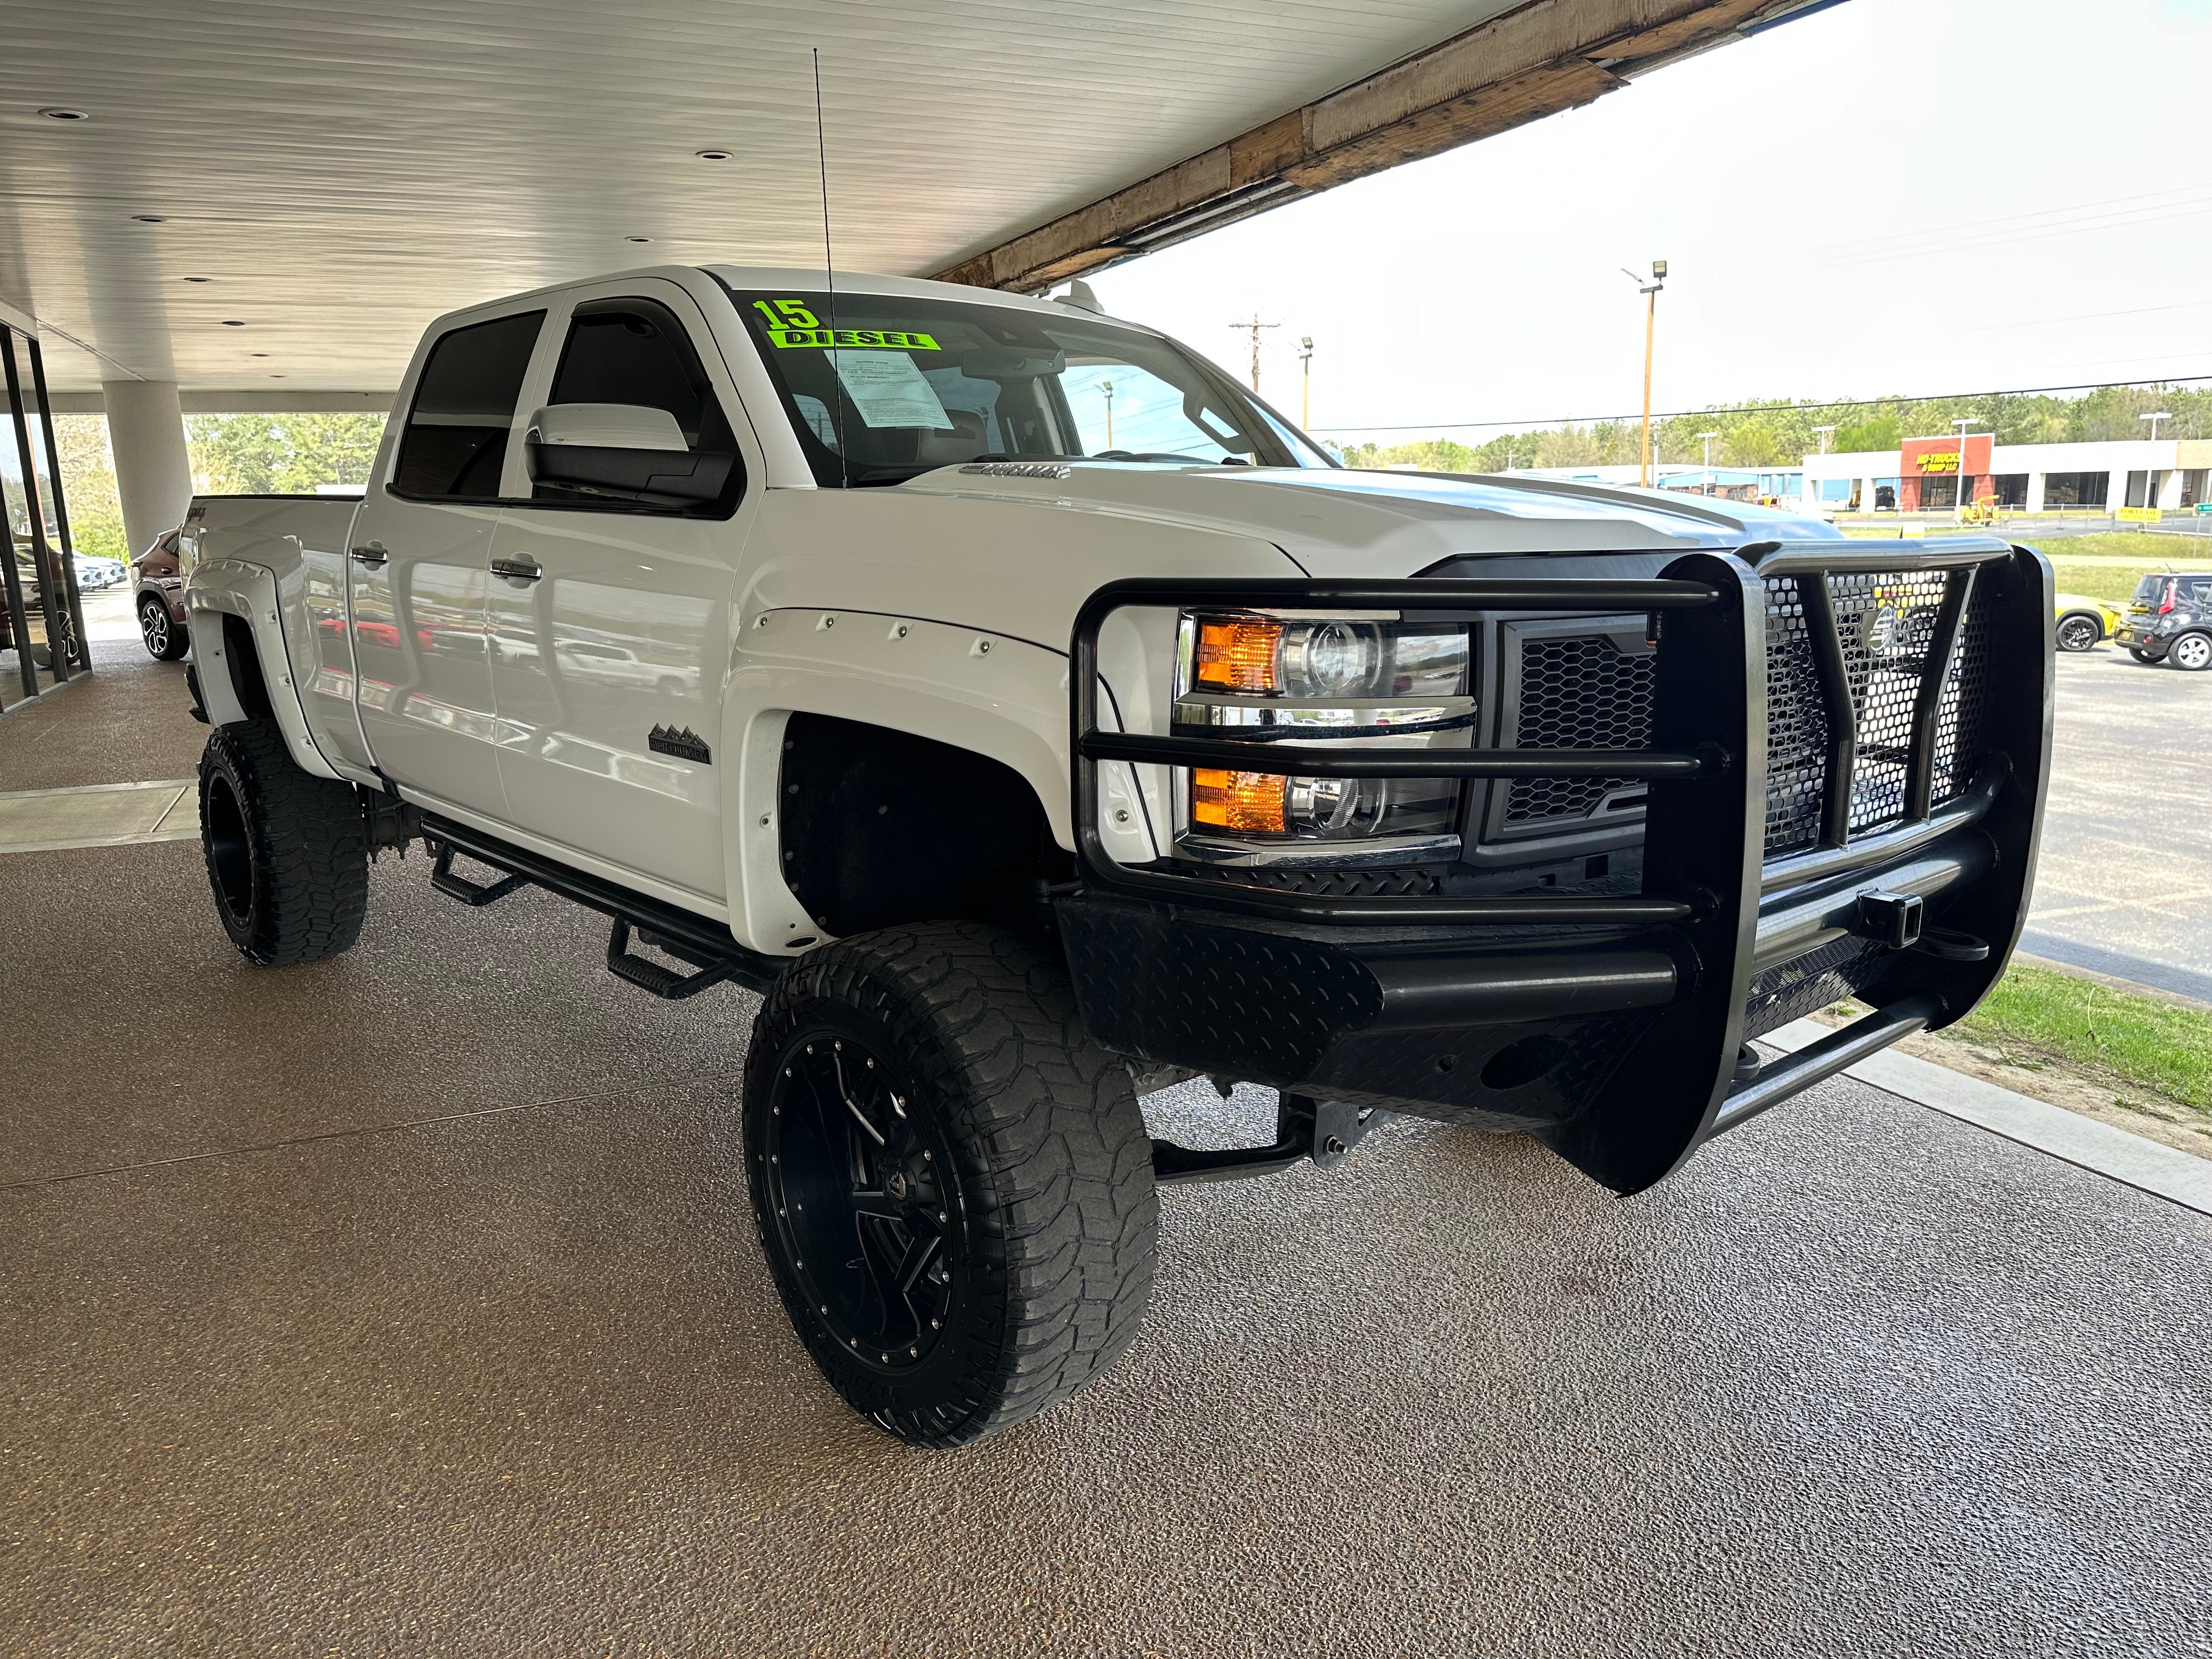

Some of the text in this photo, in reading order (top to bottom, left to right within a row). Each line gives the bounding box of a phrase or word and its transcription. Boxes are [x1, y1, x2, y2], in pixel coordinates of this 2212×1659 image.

[752, 299, 820, 330] 15
[783, 330, 926, 347] DIESEL
[651, 739, 708, 759] HIGH COUNTRY
